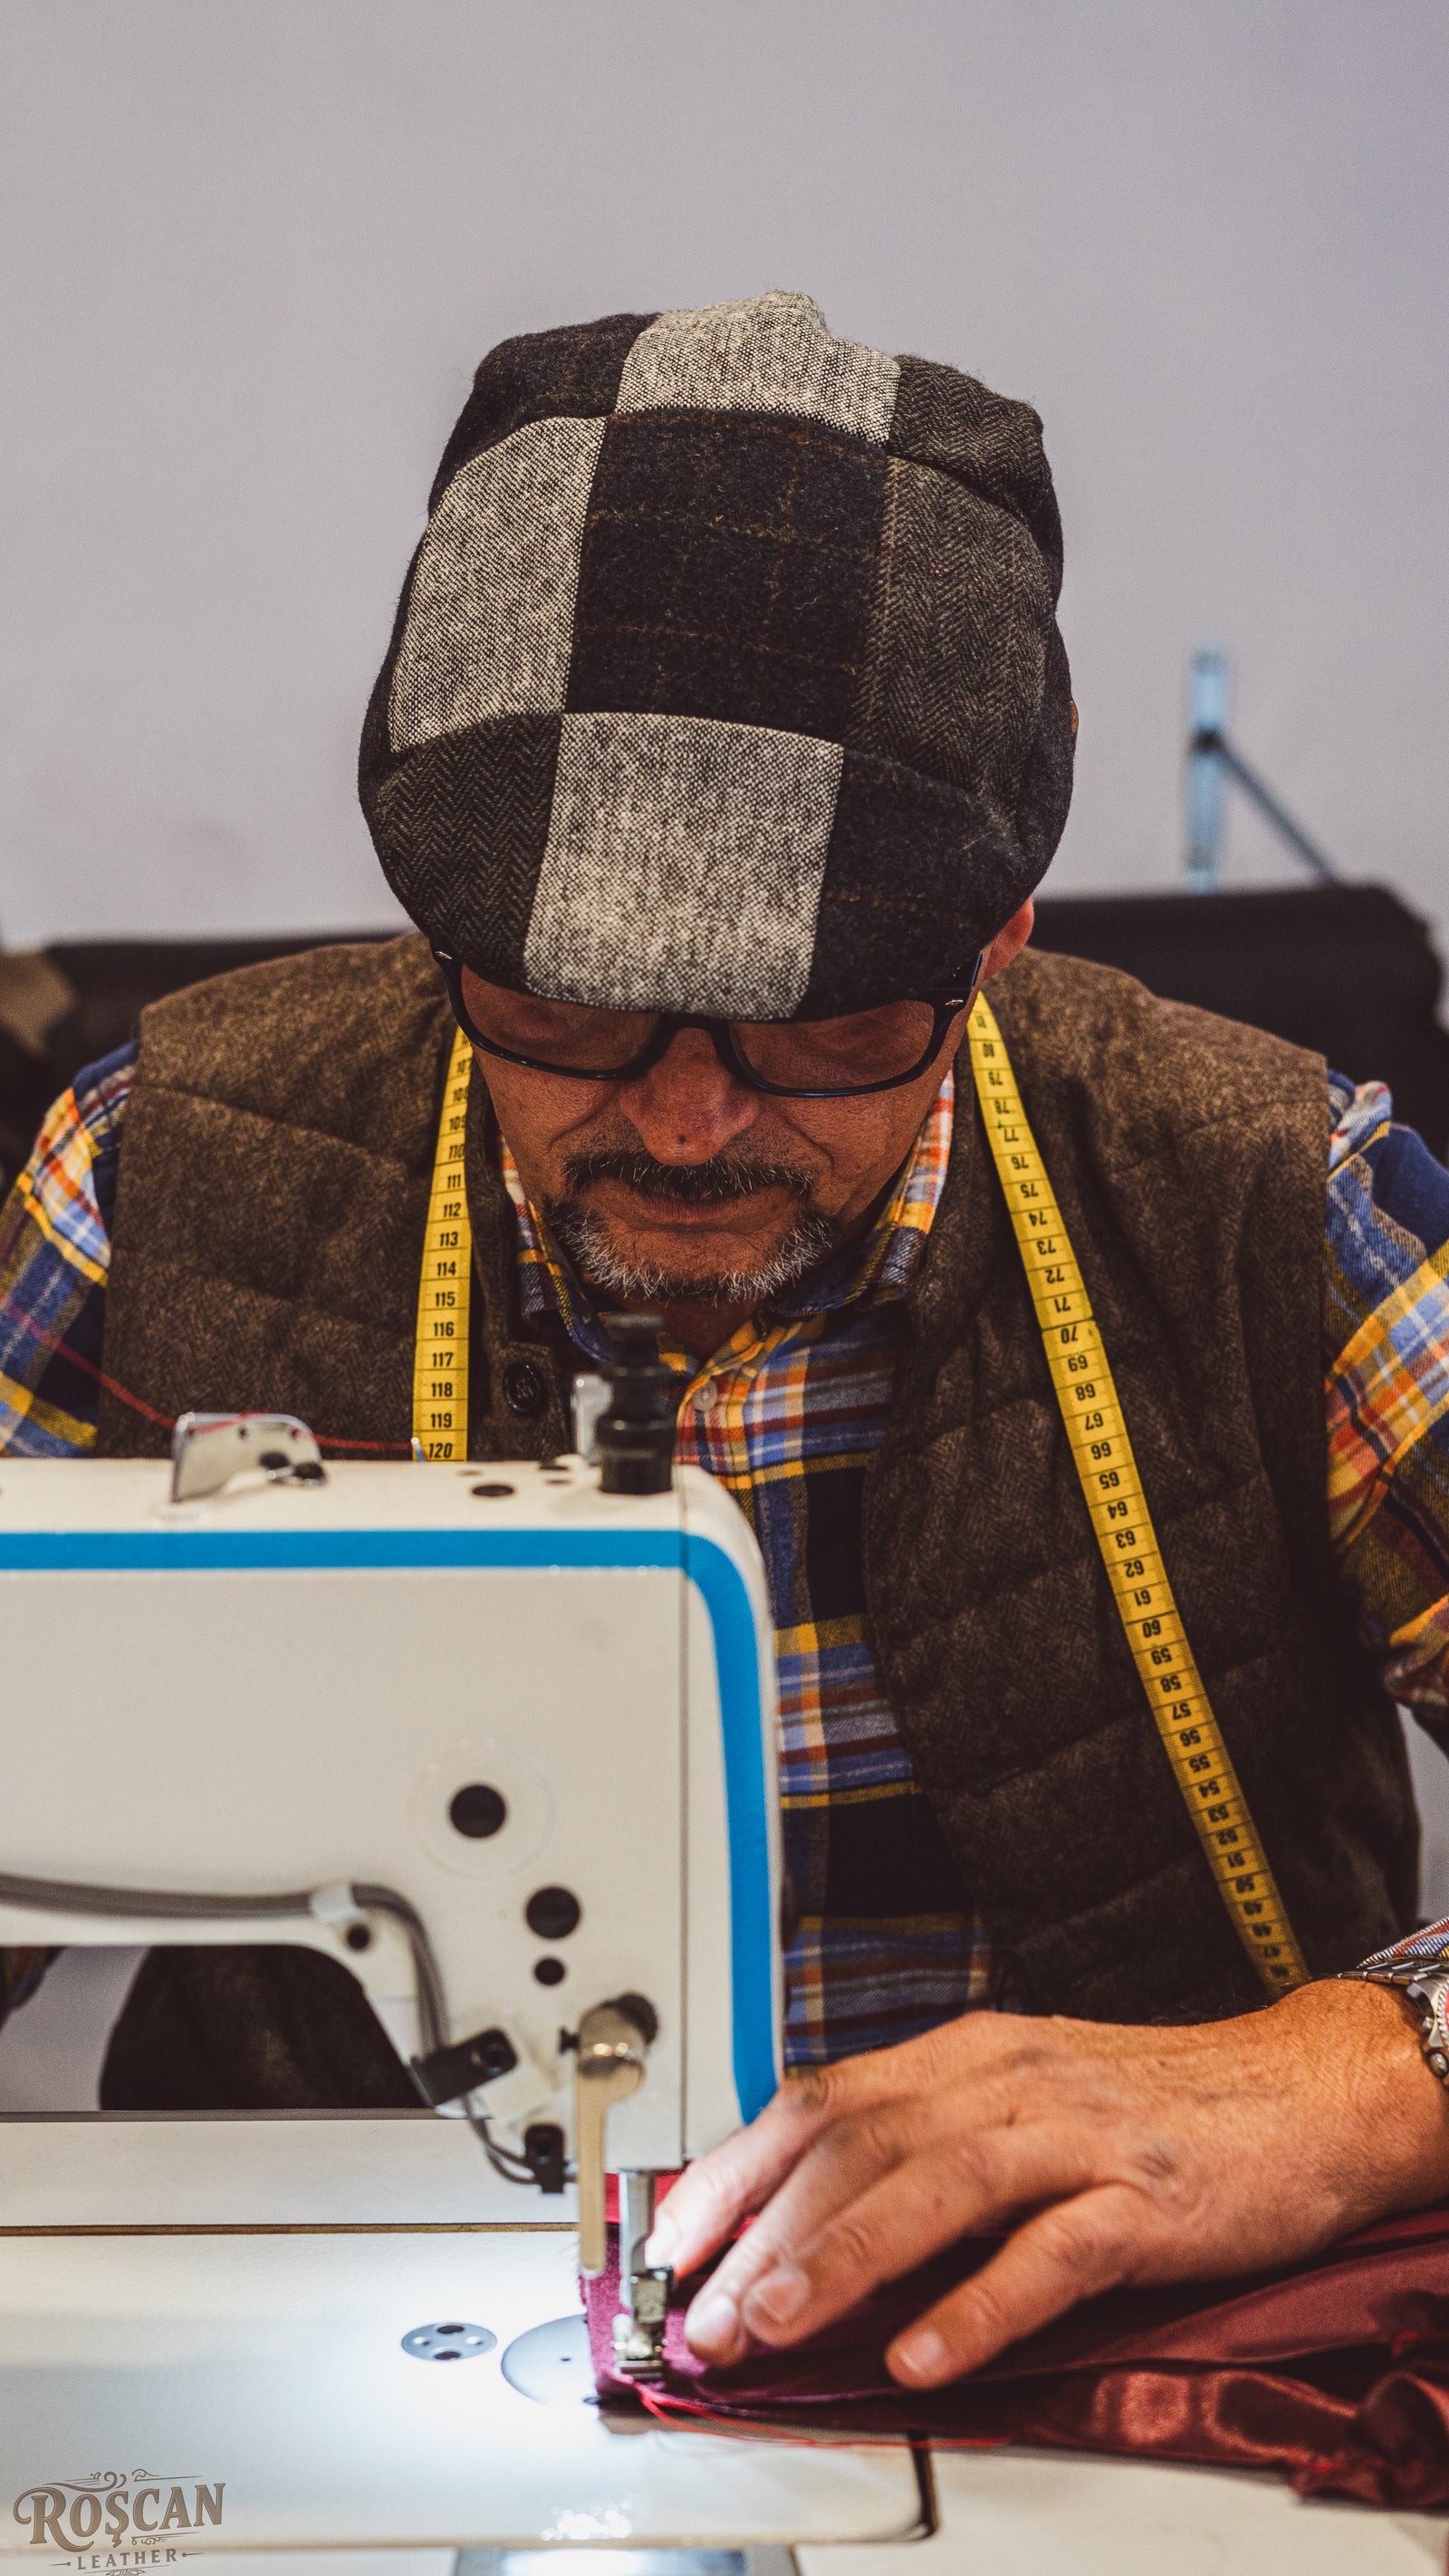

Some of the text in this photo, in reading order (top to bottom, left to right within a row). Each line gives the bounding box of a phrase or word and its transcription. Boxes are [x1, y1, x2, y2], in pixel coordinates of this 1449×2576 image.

[1004, 1129, 1019, 1142] 77
[449, 1143, 465, 1159] 110
[1011, 1156, 1029, 1169] 76
[447, 1174, 461, 1188] 111
[1021, 1183, 1039, 1198] 75
[443, 1203, 461, 1217] 112
[1029, 1211, 1048, 1226] 74
[439, 1232, 458, 1246] 113
[1037, 1239, 1056, 1254] 73
[437, 1261, 456, 1276] 114
[1045, 1268, 1064, 1283] 72
[435, 1292, 456, 1306] 115
[1053, 1296, 1071, 1312] 71
[434, 1322, 455, 1337] 116
[1060, 1325, 1079, 1344] 70
[432, 1352, 453, 1367] 117
[1068, 1355, 1089, 1372] 69
[431, 1382, 453, 1398] 118
[1075, 1383, 1096, 1401] 68
[430, 1413, 452, 1428] 119
[1085, 1412, 1104, 1430] 67
[428, 1443, 452, 1458] 120
[1090, 1442, 1112, 1460] 66
[1099, 1471, 1119, 1489] 65
[1107, 1501, 1128, 1519] 64
[1115, 1531, 1137, 1549] 63
[1124, 1560, 1145, 1578] 62
[1134, 1589, 1151, 1607] 61
[1142, 1620, 1161, 1638] 60
[1151, 1648, 1173, 1666] 59
[1160, 1676, 1182, 1694] 58
[1172, 1703, 1192, 1720] 57
[1179, 1729, 1201, 1747] 56
[1188, 1754, 1211, 1773] 55
[1198, 1780, 1221, 1798] 54
